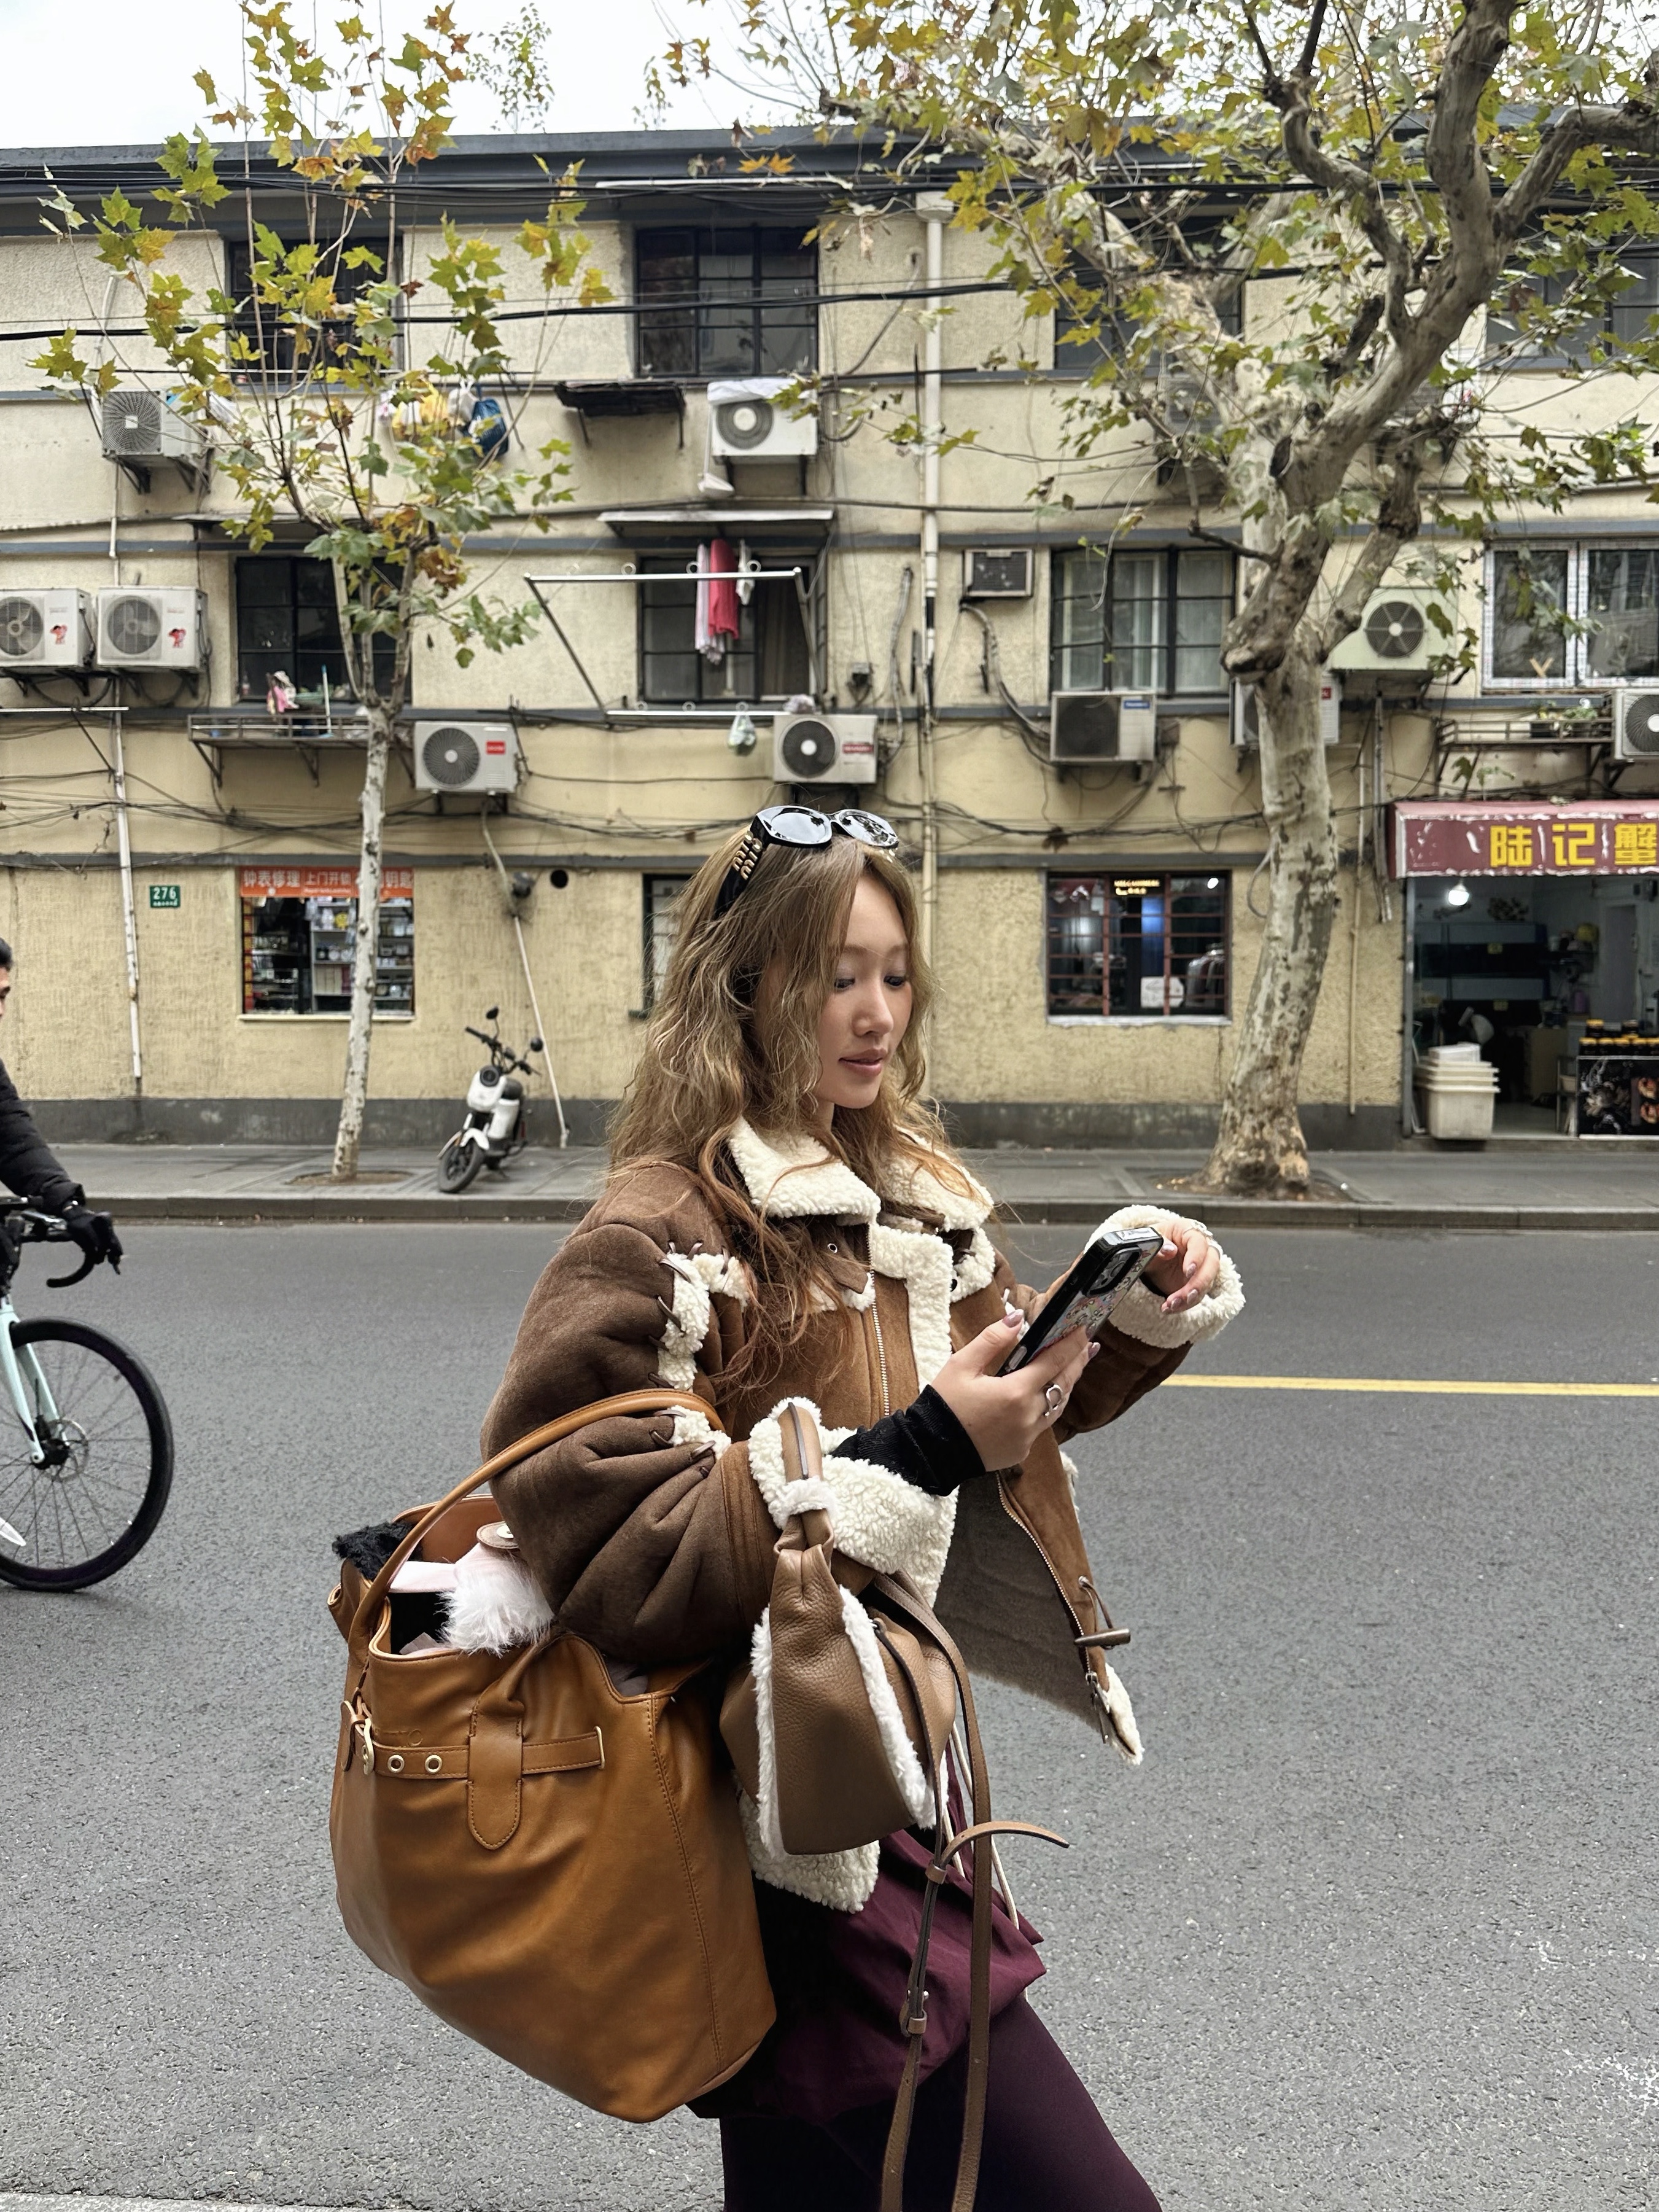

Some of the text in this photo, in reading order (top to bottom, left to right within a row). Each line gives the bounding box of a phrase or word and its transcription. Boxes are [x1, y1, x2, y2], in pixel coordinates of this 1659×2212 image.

[1490, 822, 1657, 867] 陆记蟹
[243, 869, 300, 888] 钟表修理
[153, 887, 177, 900] 276
